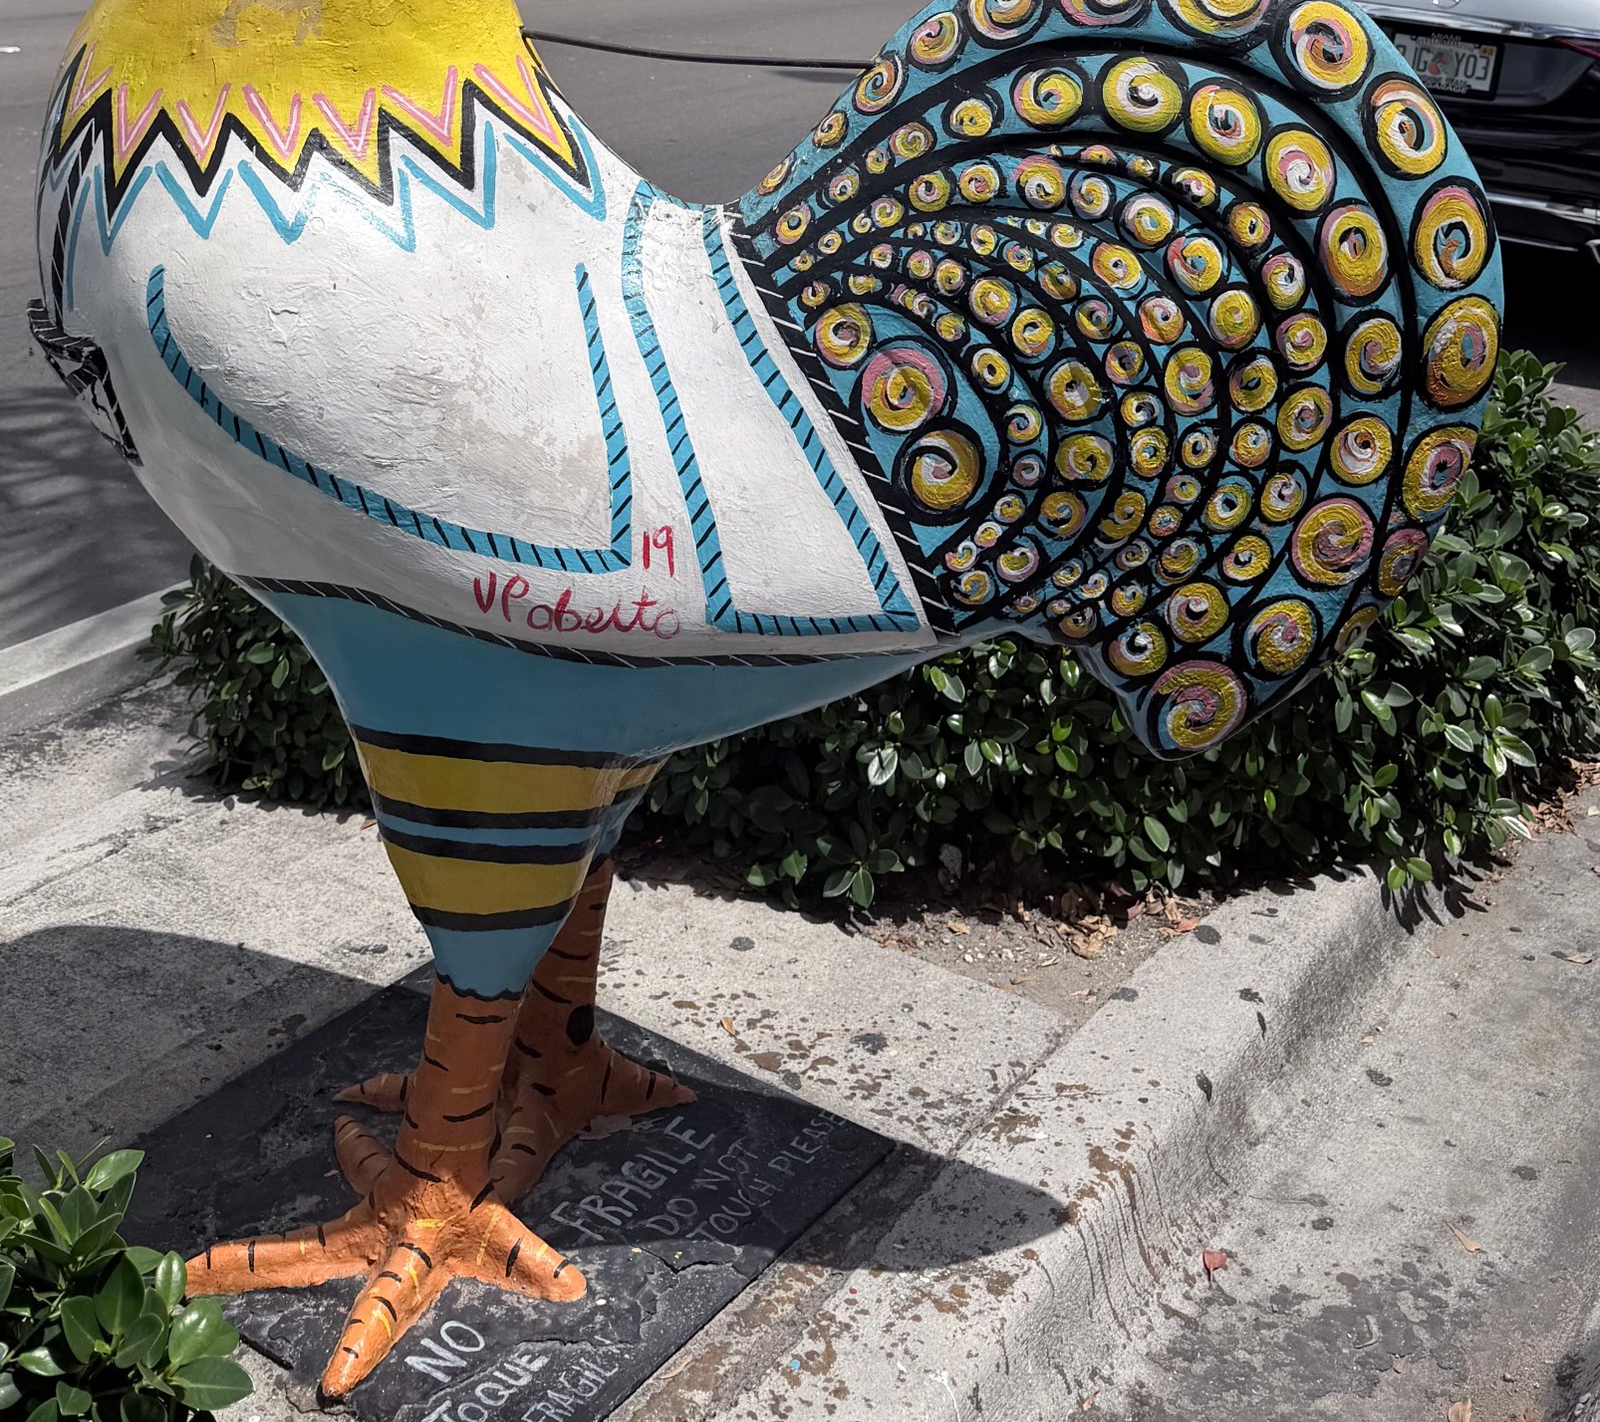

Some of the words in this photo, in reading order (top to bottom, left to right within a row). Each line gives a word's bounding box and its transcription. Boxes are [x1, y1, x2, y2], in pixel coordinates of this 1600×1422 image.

[642, 526, 675, 578] 19
[551, 1115, 716, 1242] FRAGILE
[643, 1197, 698, 1236] DO
[694, 1136, 759, 1191] NOT
[685, 1178, 784, 1248] TOUCH
[768, 1110, 847, 1176] PLEASE
[404, 1320, 485, 1383] NO
[421, 1353, 551, 1422] TOQUE
